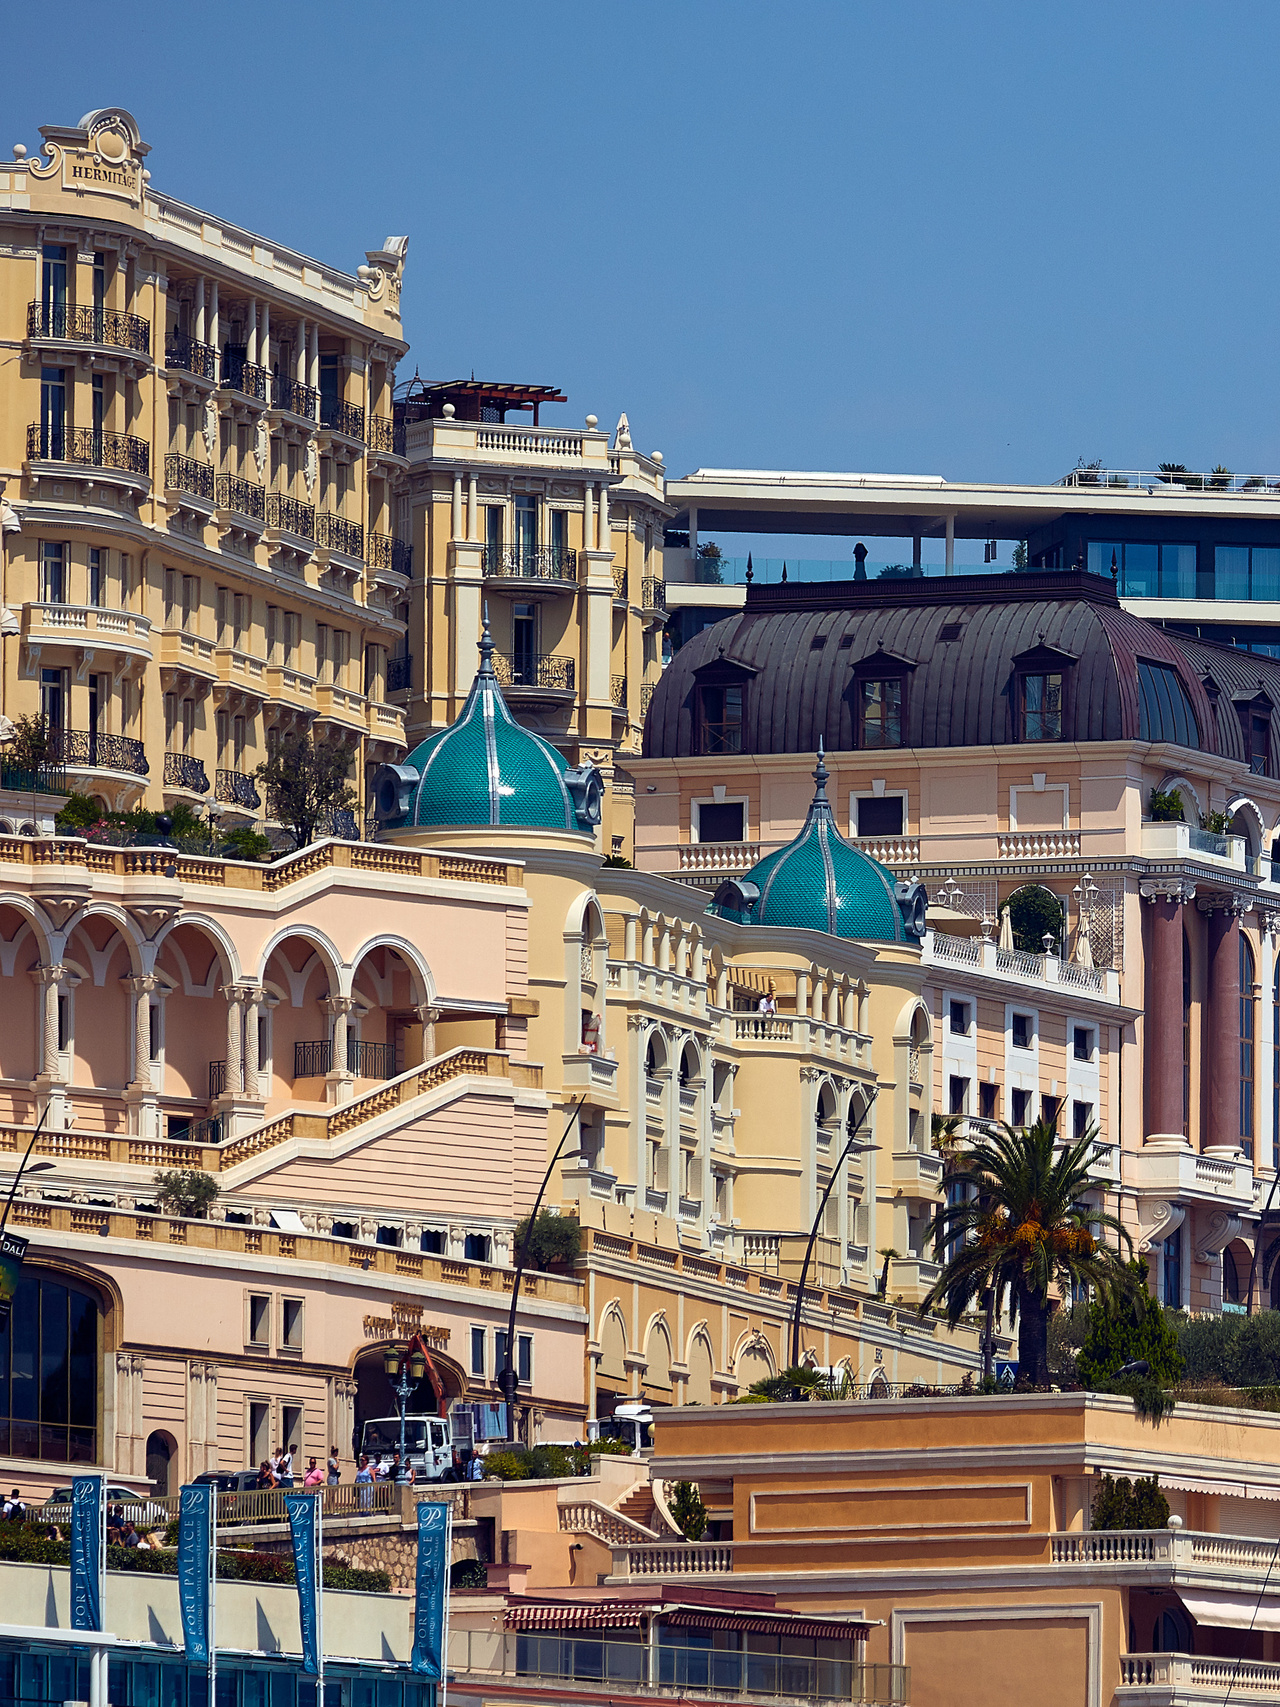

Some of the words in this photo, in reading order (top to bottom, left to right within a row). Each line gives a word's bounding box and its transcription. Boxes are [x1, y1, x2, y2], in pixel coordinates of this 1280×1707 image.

[72, 166, 136, 190] HERMITAGE
[2, 1241, 26, 1257] DALÍ
[75, 1510, 87, 1576] PALACE
[183, 1520, 195, 1586] PALACE
[419, 1535, 433, 1599] PALACE
[75, 1583, 86, 1627] PORT
[184, 1593, 196, 1636] PORT
[417, 1606, 428, 1649] PORT
